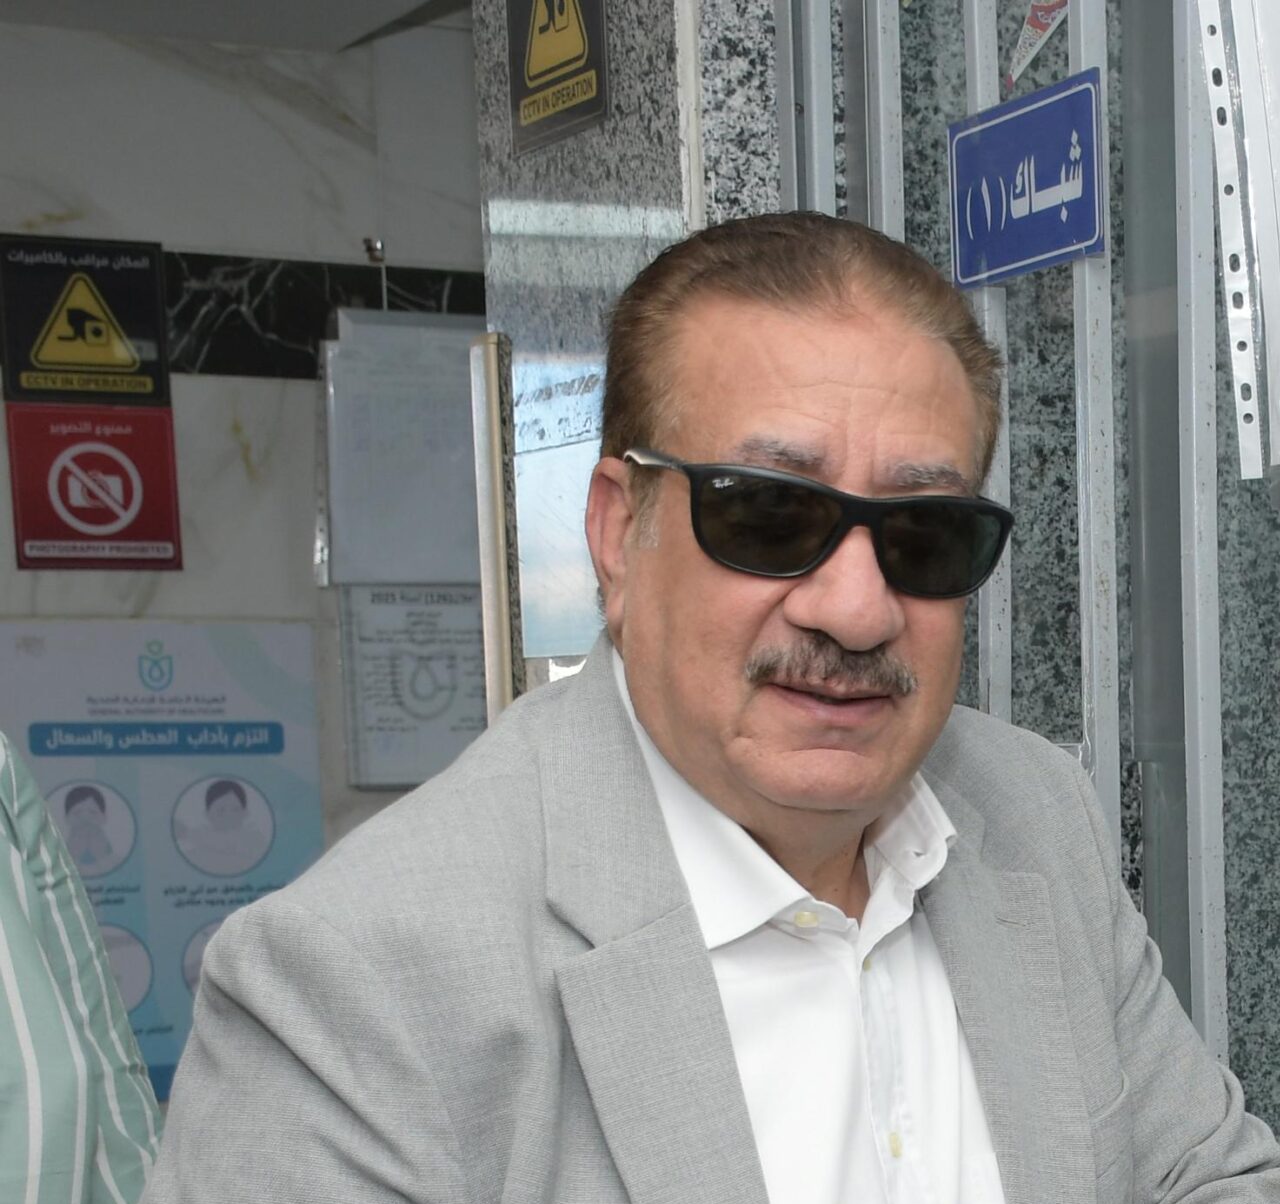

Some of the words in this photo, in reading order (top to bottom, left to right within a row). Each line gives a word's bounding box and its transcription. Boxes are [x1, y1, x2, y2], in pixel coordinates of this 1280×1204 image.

[523, 99, 541, 121] CCTV
[541, 94, 551, 113] IN
[551, 75, 594, 105] OPERATION
[1009, 128, 1083, 224] شباك
[7, 250, 68, 266] بالكاميرات
[70, 253, 110, 268] مراقب
[112, 256, 150, 271] المكان
[26, 375, 58, 386] CCTV
[61, 376, 75, 387] IN
[77, 377, 148, 390] OPERATION
[50, 421, 92, 435] التصوير
[95, 424, 133, 436] ممنوع
[46, 728, 113, 750] والسعال
[118, 729, 178, 749] العطس
[232, 727, 269, 747] التزم
